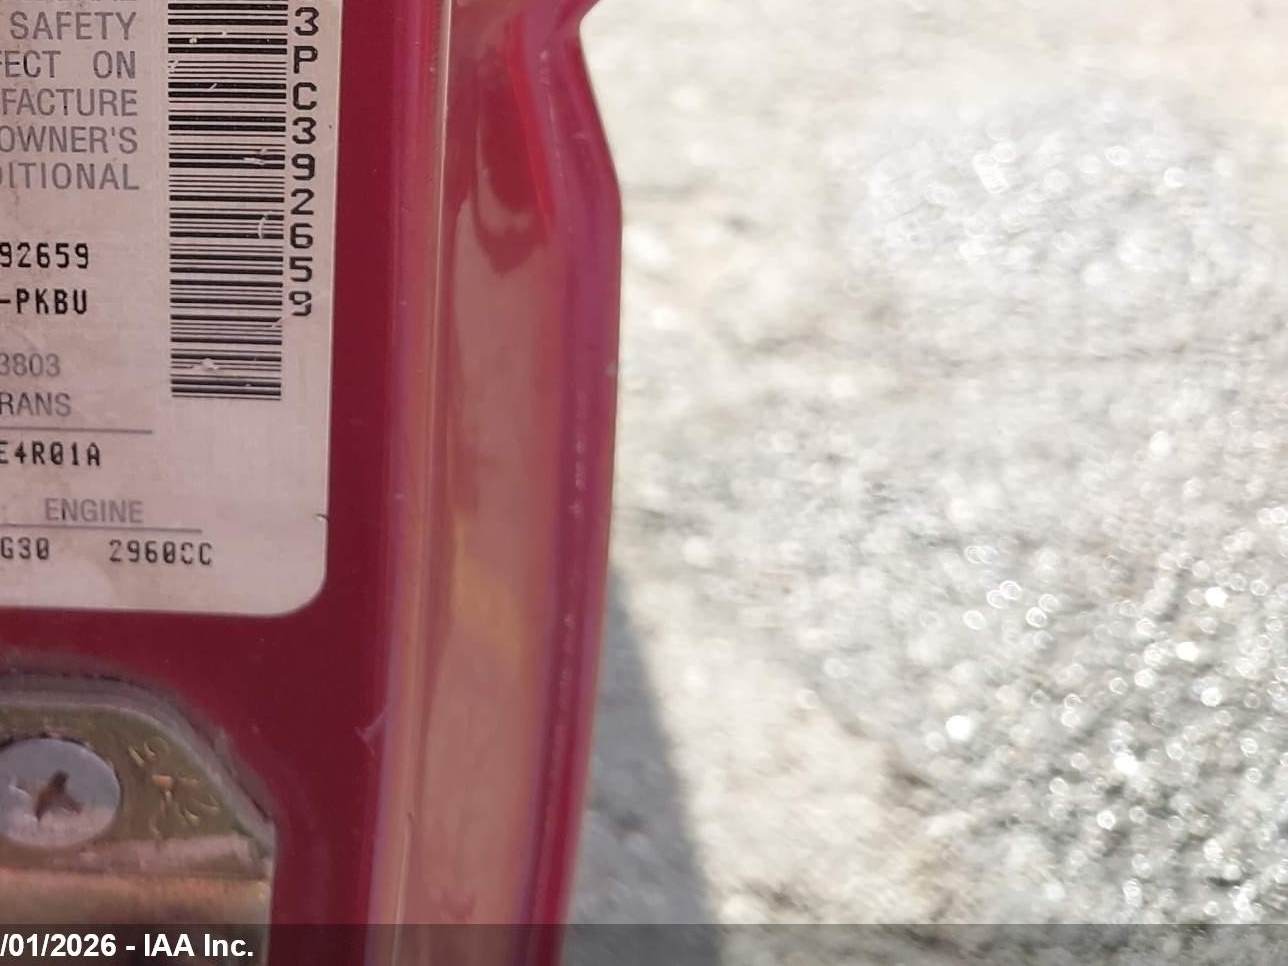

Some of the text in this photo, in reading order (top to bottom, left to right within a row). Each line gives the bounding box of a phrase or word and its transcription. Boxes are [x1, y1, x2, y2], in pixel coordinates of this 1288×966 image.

[10, 11, 136, 41] SAFETY
[93, 50, 135, 79] ON
[45, 498, 143, 524] ENGINE
[109, 540, 213, 566] 2960CC
